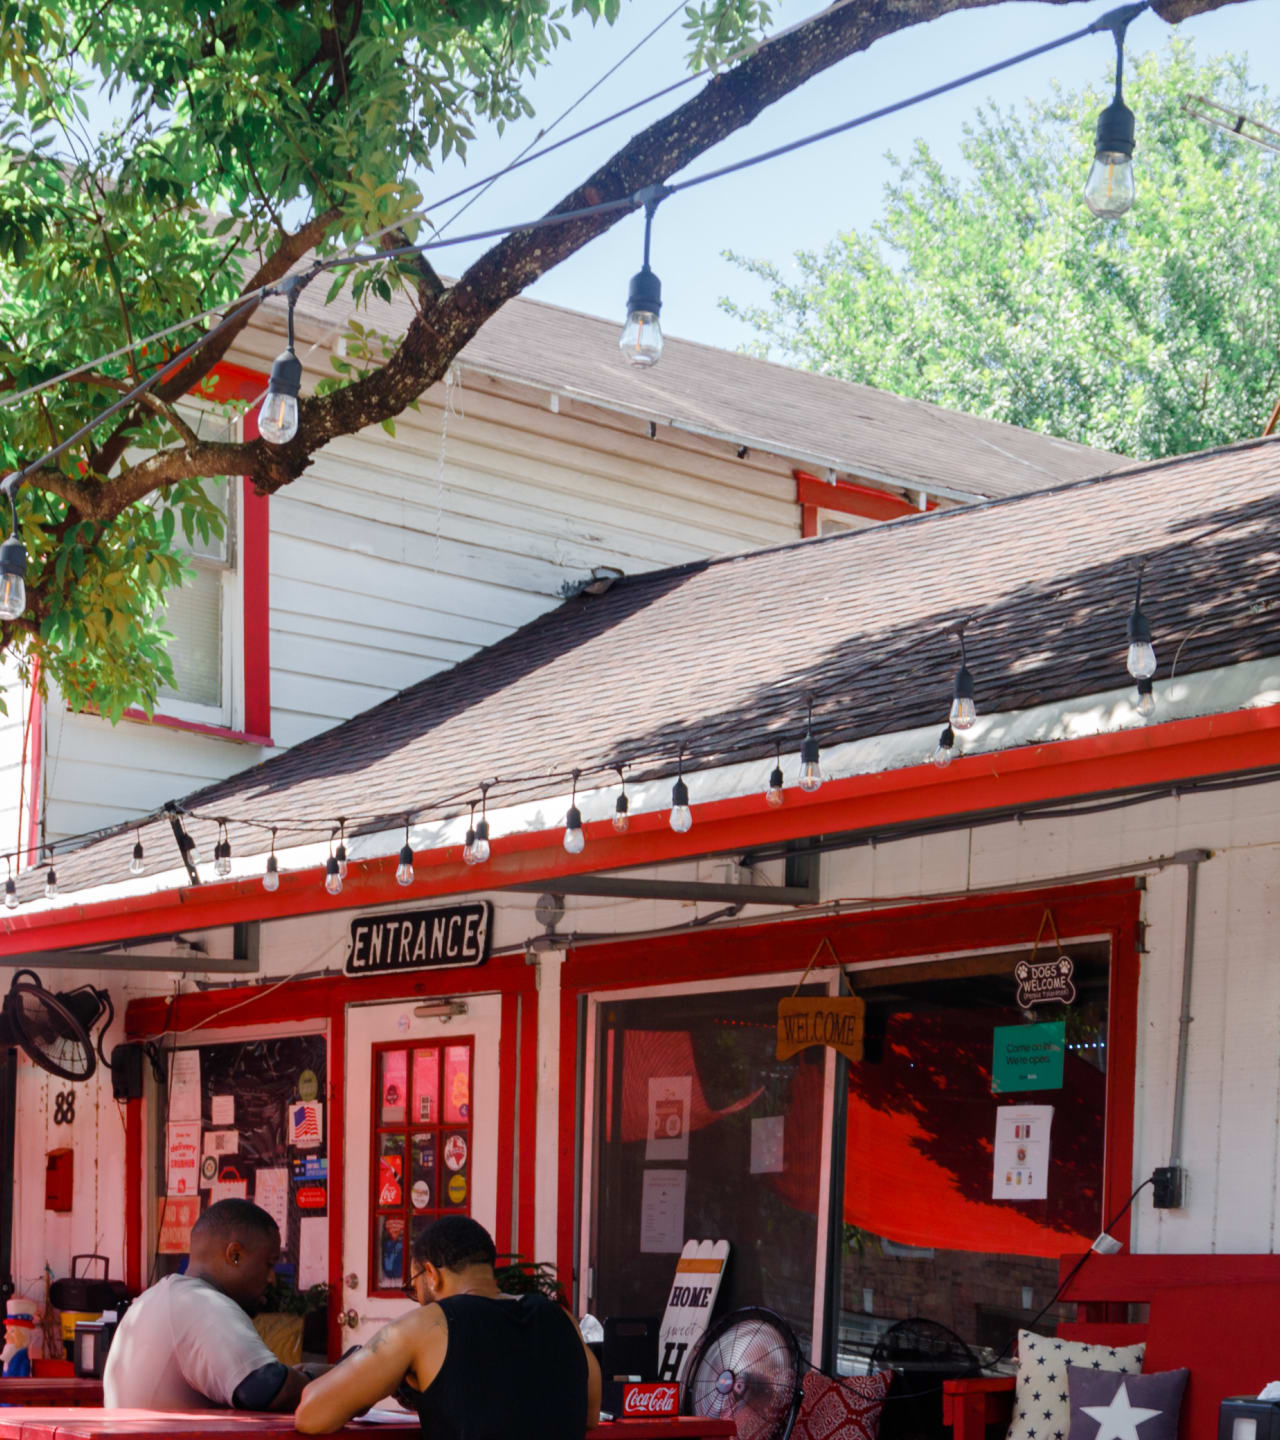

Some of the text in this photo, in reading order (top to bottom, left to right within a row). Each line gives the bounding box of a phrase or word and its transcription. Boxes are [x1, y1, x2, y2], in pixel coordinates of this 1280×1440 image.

[352, 914, 480, 967] ENTRANCE
[1031, 965, 1058, 979] DOGS
[1023, 976, 1066, 993] WELCOME
[783, 1010, 856, 1046] WELCOME
[54, 1090, 76, 1125] 88
[669, 1286, 712, 1308] HOME
[662, 1320, 700, 1341] sweet
[624, 1386, 677, 1412] Coca-Cola
